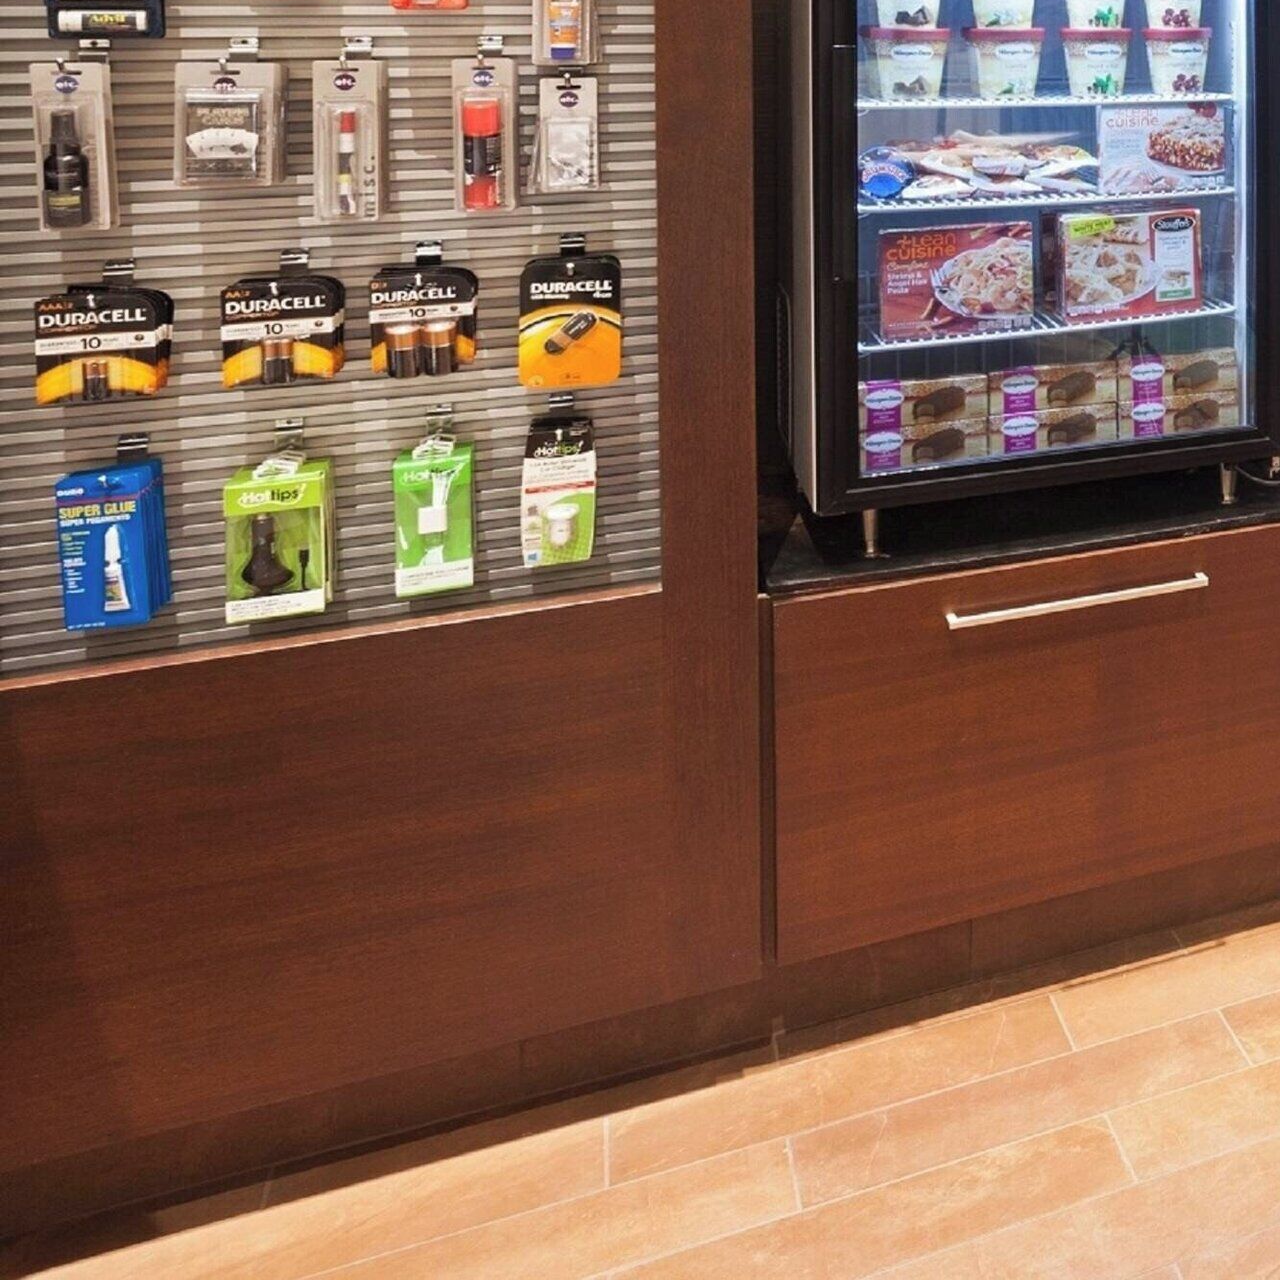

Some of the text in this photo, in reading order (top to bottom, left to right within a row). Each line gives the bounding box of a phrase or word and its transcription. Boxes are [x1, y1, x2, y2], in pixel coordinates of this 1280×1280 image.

[364, 155, 376, 217] misc.
[372, 286, 456, 305] DURACELL
[530, 281, 612, 293] DURACELL
[225, 295, 326, 314] DURACELL
[409, 307, 426, 318] 10
[39, 308, 146, 327] DURACELL
[264, 324, 283, 335] 10
[81, 337, 101, 349] 10
[59, 501, 136, 519] SUPER GLUE
